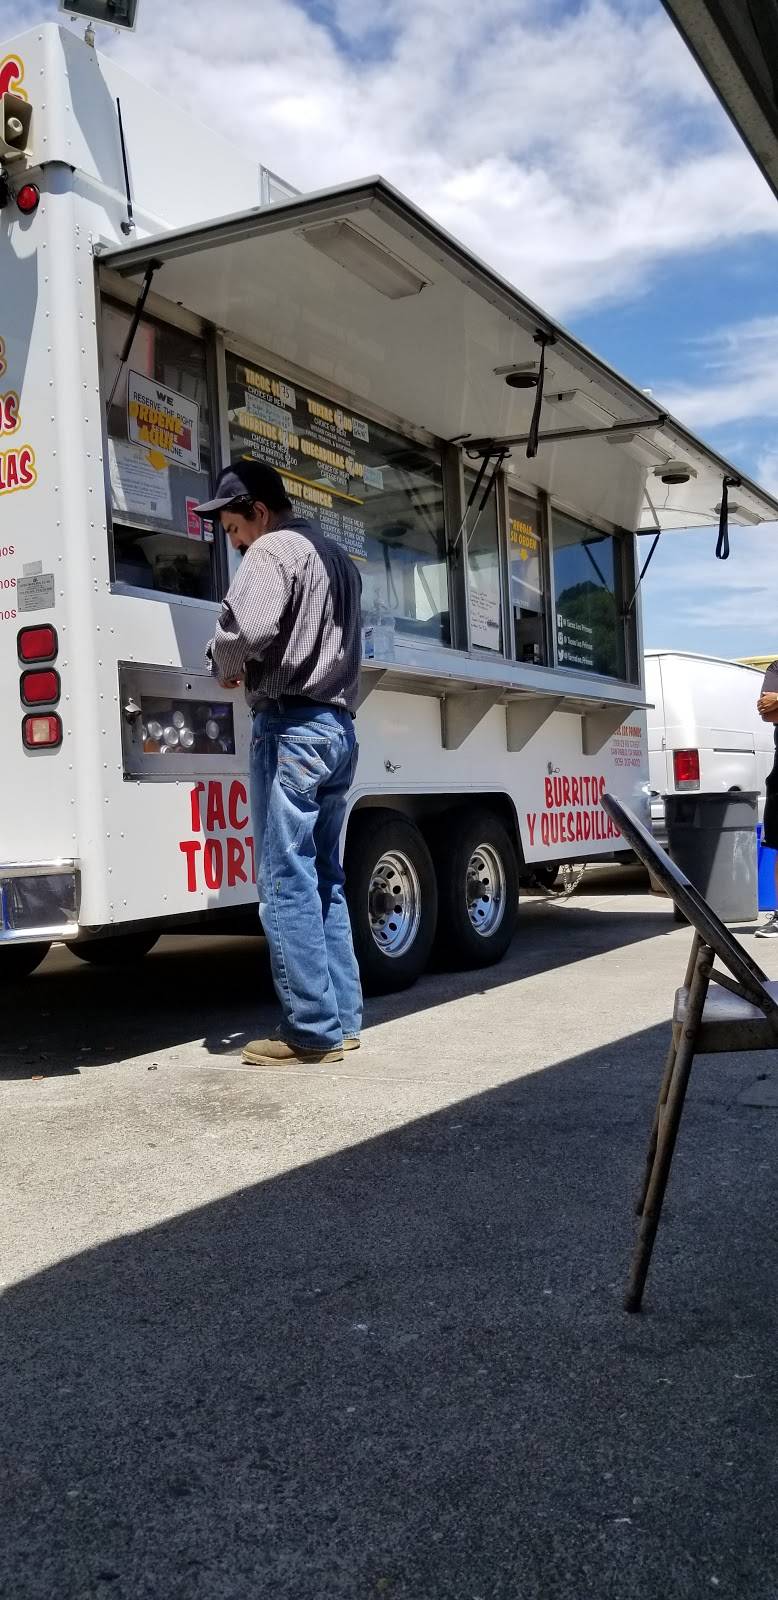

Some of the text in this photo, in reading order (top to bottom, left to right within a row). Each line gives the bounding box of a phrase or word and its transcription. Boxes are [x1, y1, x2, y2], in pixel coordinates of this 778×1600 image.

[245, 368, 270, 393] TACOS
[248, 386, 266, 400] CHOICE
[134, 392, 162, 412] RESERVE
[177, 413, 194, 428] RIGHT
[156, 390, 174, 406] WE
[307, 398, 334, 423] TORTAS
[129, 400, 183, 434] ORDENE
[239, 412, 278, 440] BURRITOS
[314, 418, 330, 428] CHOICE
[252, 432, 270, 446] CHOICE
[300, 438, 345, 469] QUESADILLAS
[303, 482, 332, 508] CHOICES
[510, 530, 536, 550] SU ORDEN
[544, 776, 606, 808] BURRITOS
[526, 813, 536, 846] Y
